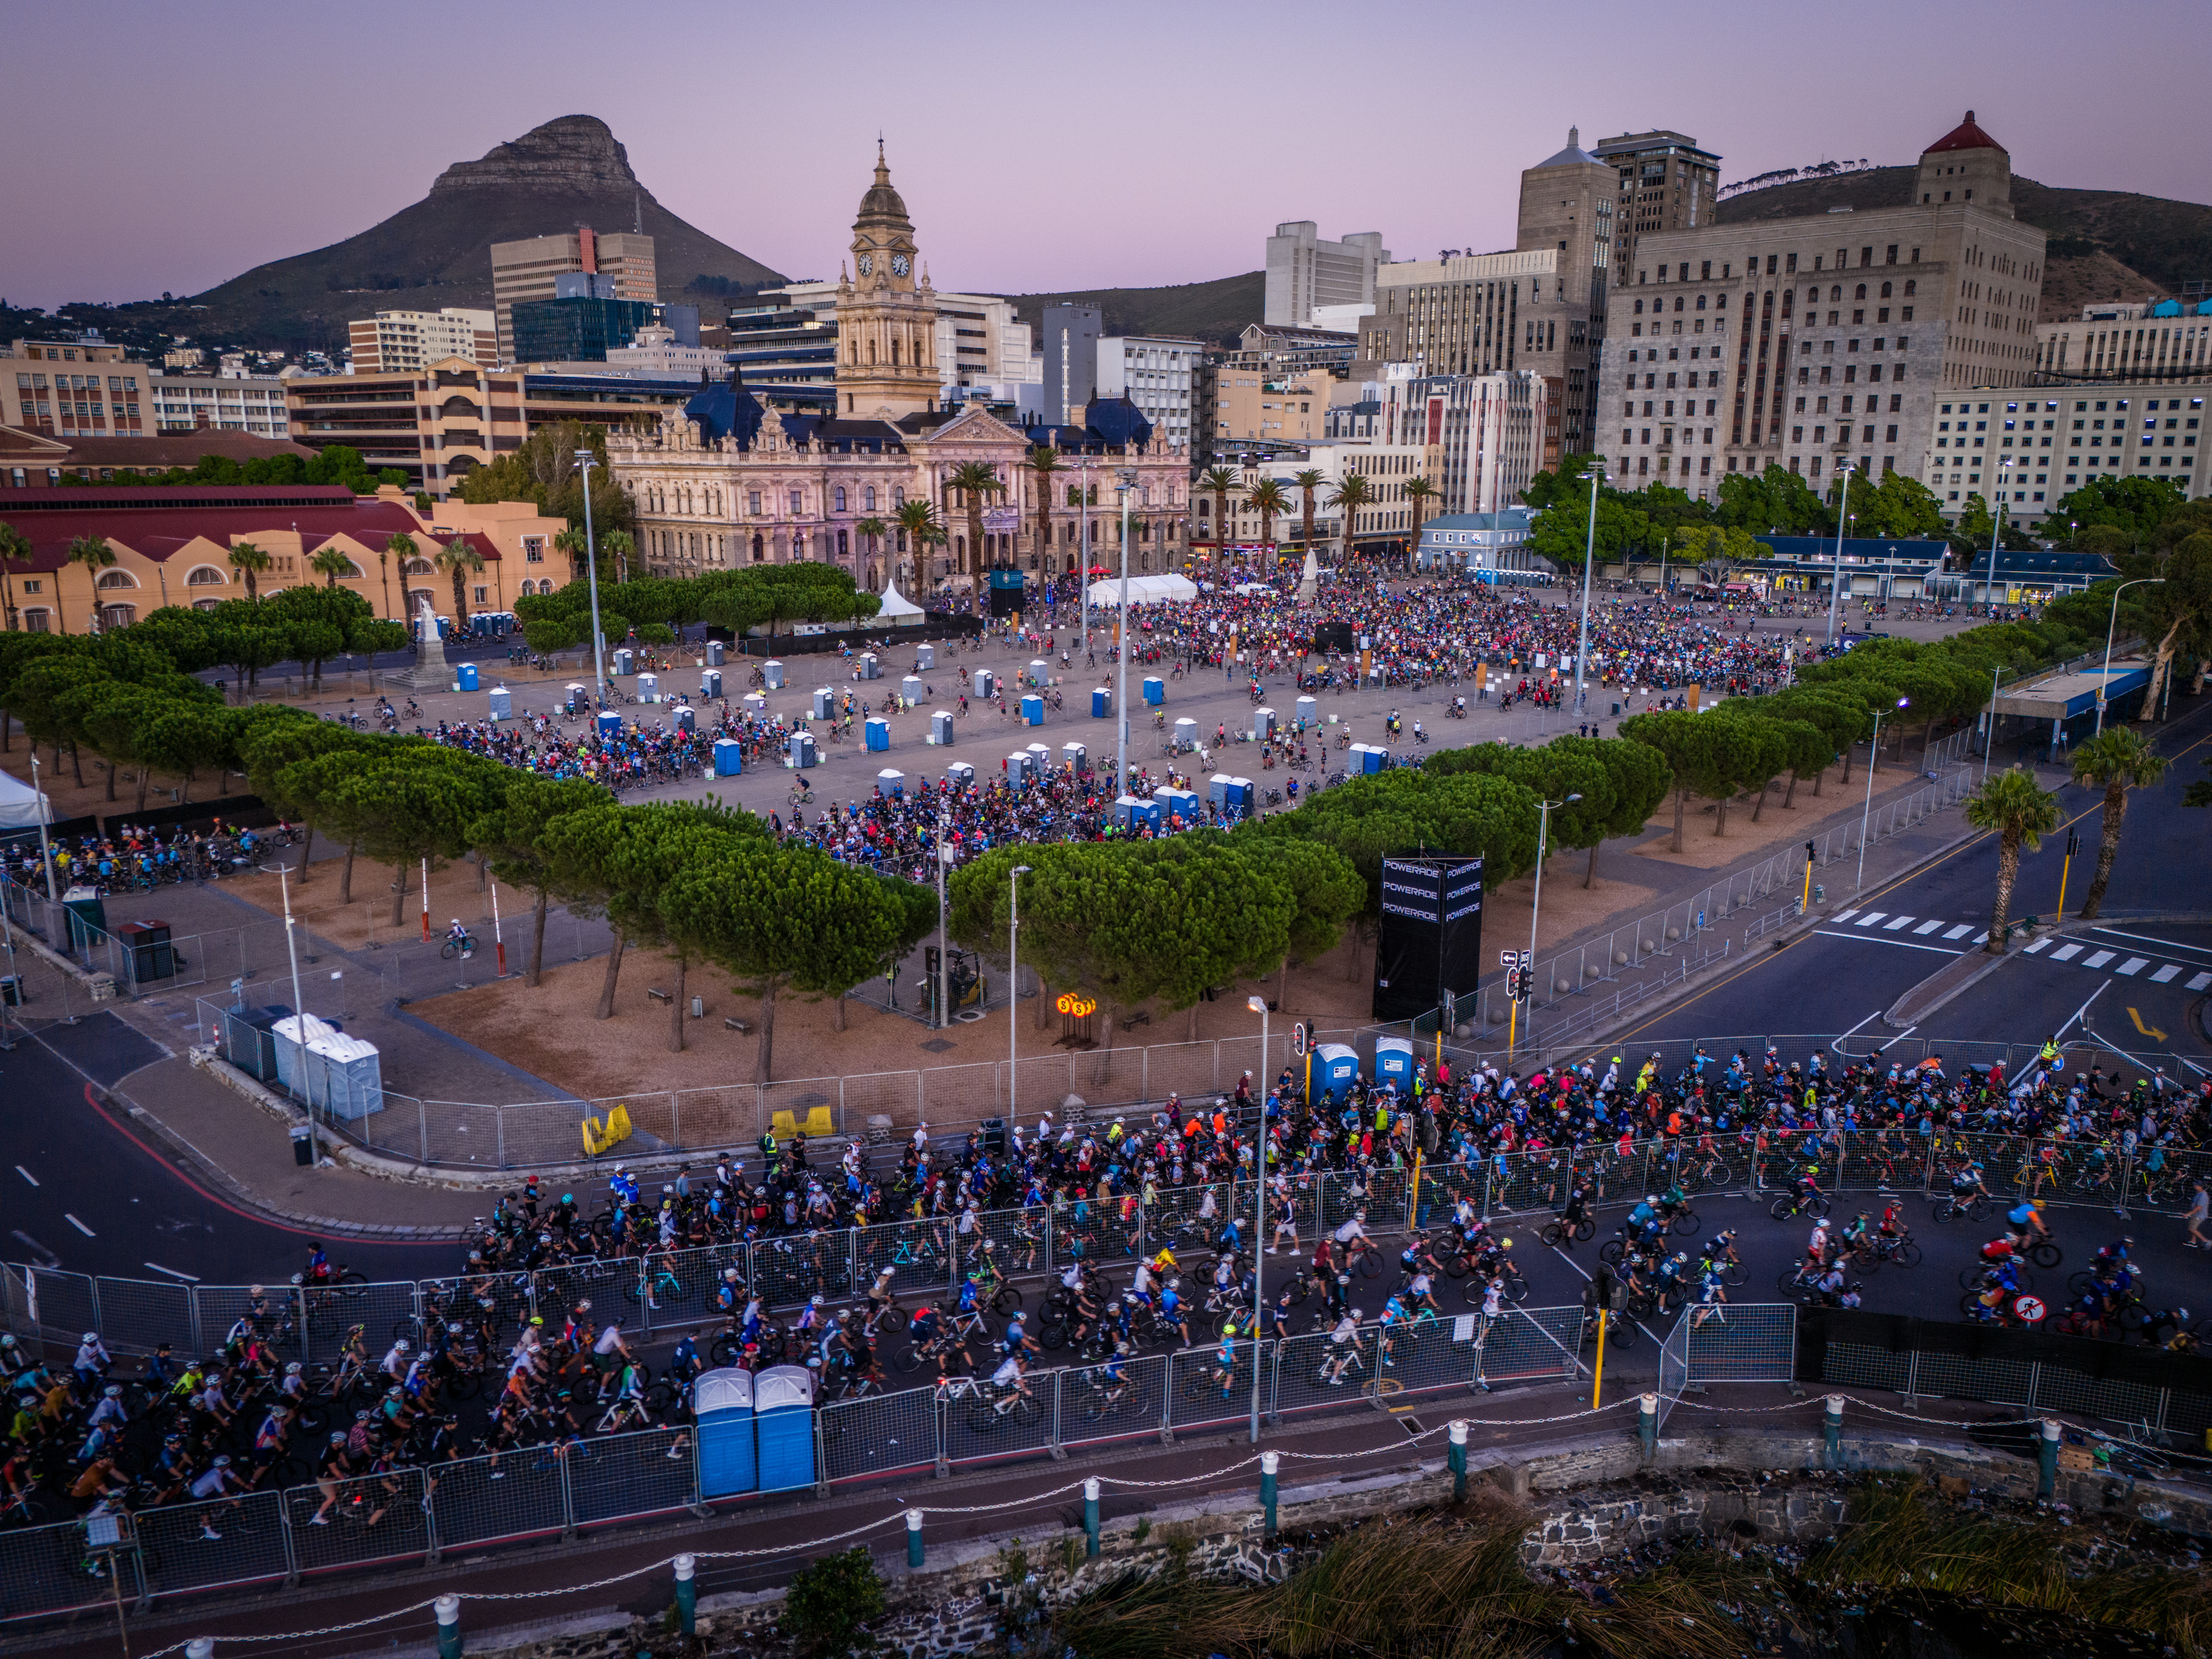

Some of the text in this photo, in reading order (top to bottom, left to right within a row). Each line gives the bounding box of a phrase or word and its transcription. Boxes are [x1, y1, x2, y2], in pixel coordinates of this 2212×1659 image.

[1384, 860, 1439, 878] POWERADE
[1447, 860, 1481, 879] POWERADE
[1383, 881, 1438, 900] POWERADE
[1447, 881, 1481, 900] POWERADE
[1382, 902, 1437, 922] POWERADE
[1446, 902, 1480, 922] POWERADE
[1521, 953, 1529, 962] BUS
